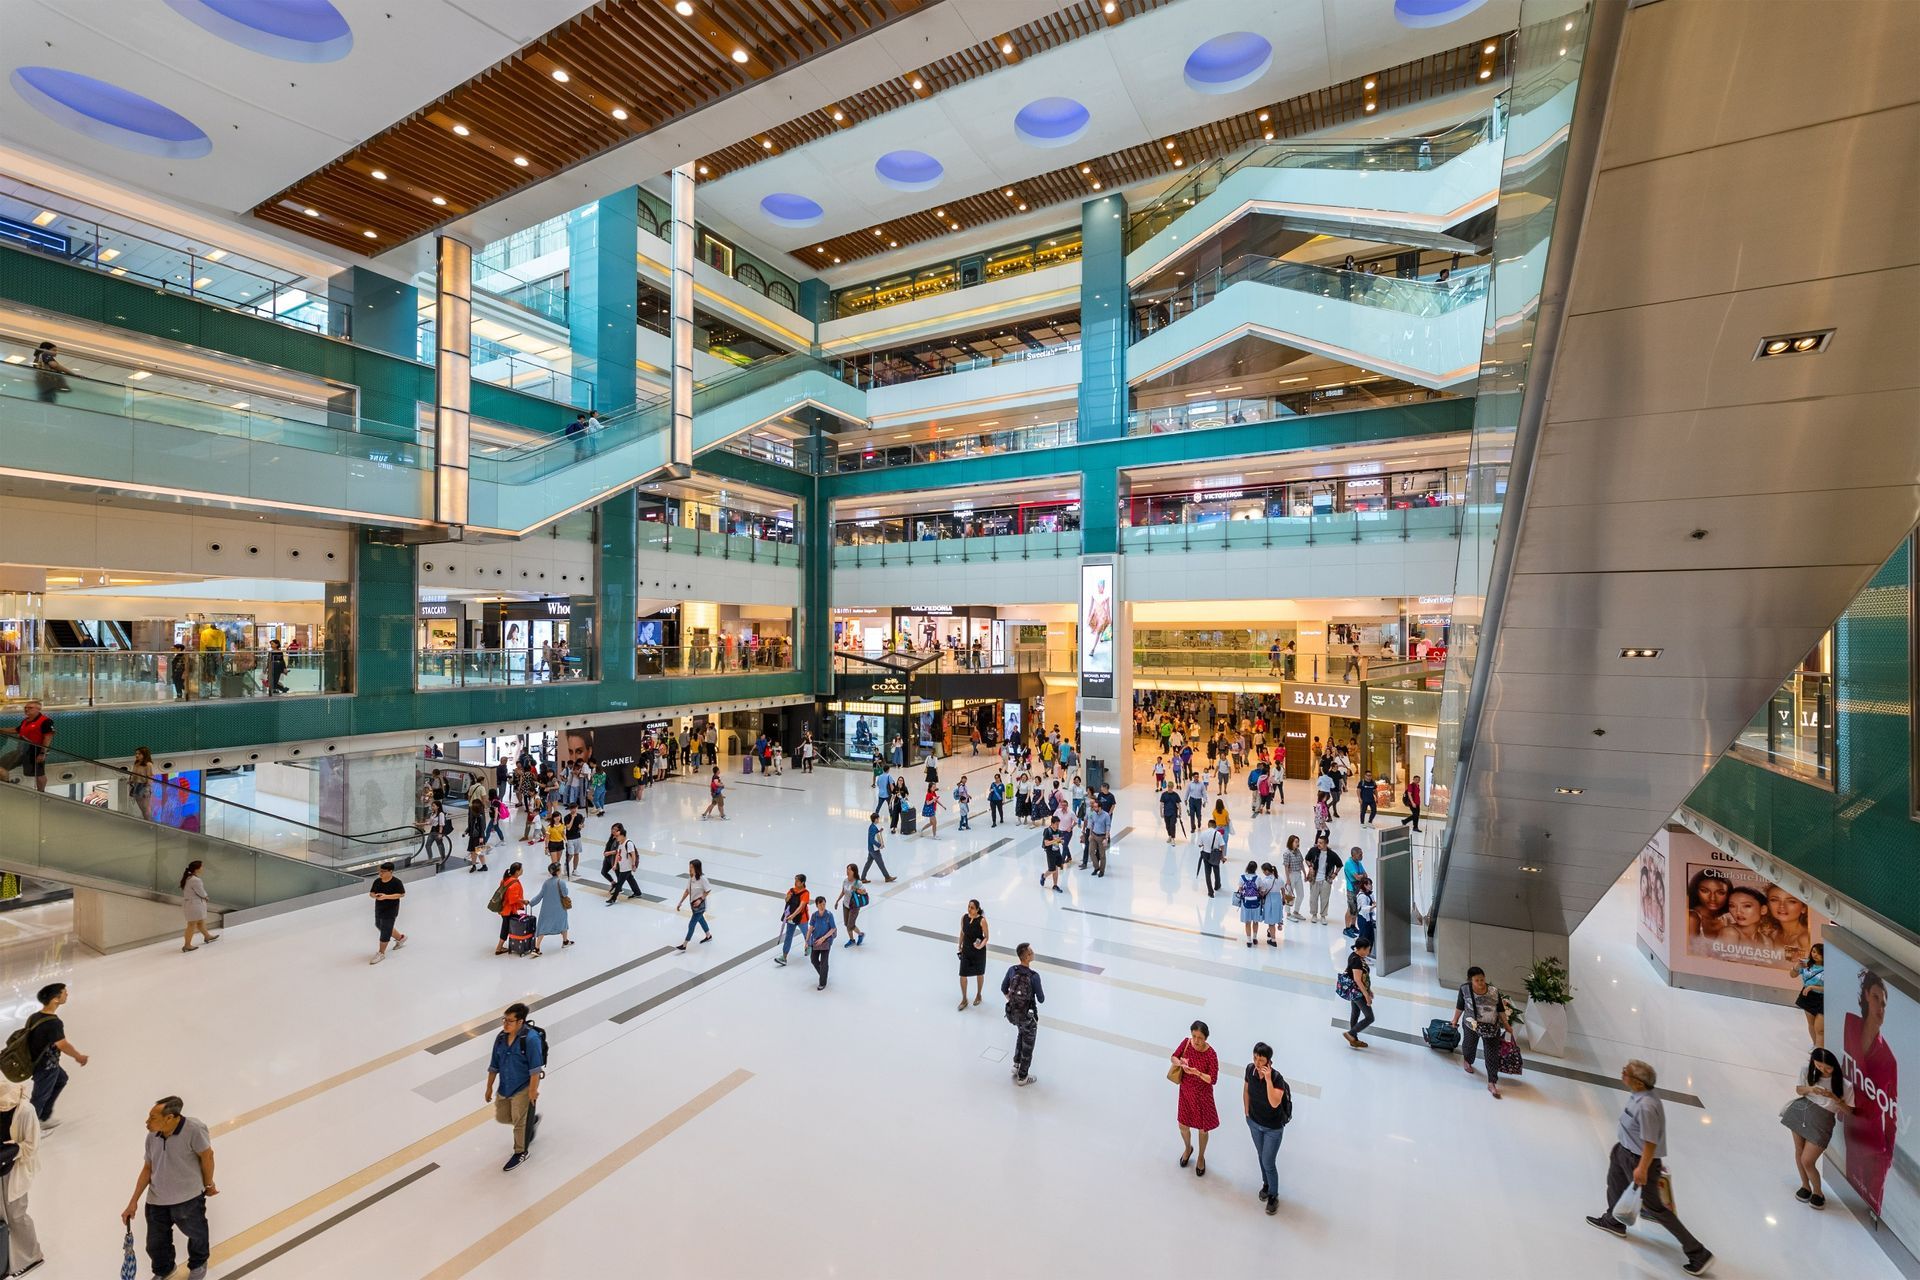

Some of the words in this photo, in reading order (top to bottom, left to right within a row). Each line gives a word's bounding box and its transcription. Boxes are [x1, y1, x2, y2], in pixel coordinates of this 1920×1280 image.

[422, 606, 447, 615] STACCATO
[1294, 690, 1351, 708] BALLY
[646, 721, 669, 729] CHANEL
[601, 756, 635, 768] CHANEL
[1711, 851, 1740, 863] GLO
[1703, 867, 1756, 880] Charlotte
[1712, 942, 1782, 961] GLOWGASM
